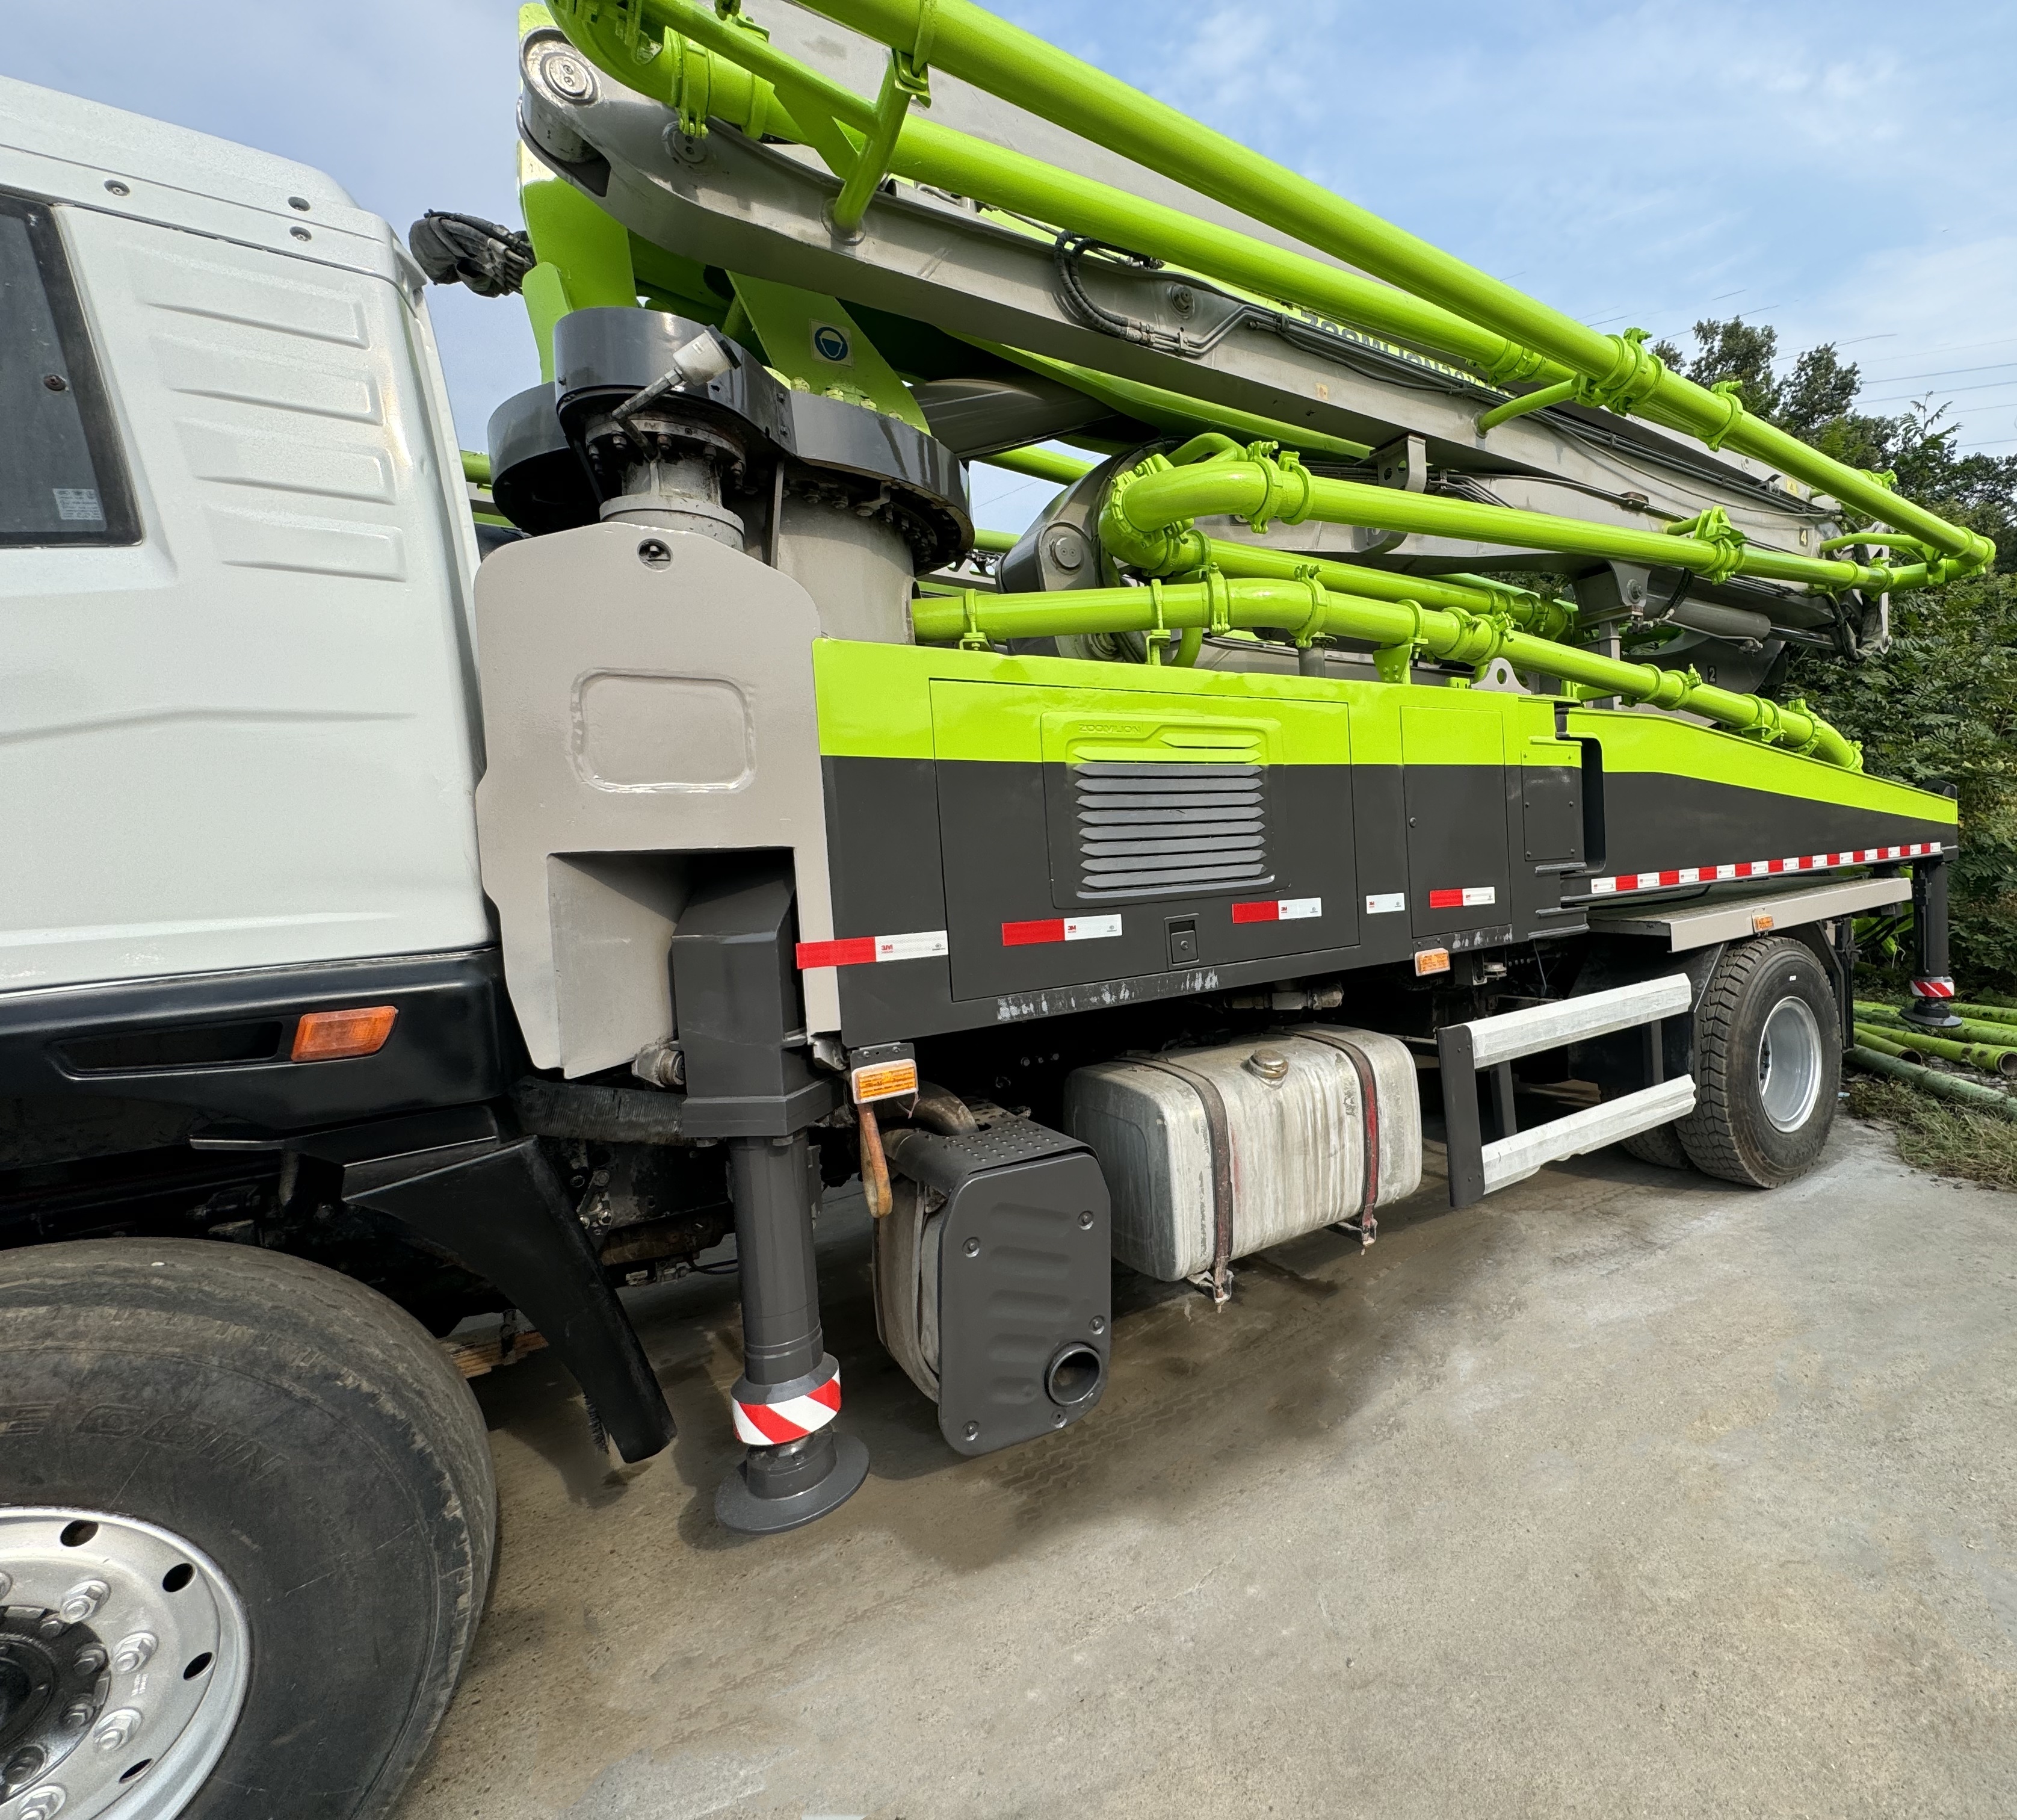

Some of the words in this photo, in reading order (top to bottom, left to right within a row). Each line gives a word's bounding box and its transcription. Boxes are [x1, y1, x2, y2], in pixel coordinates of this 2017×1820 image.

[1801, 530, 1807, 545] 4
[1709, 667, 1716, 682] 2
[1078, 724, 1141, 734] ZOOMLION
